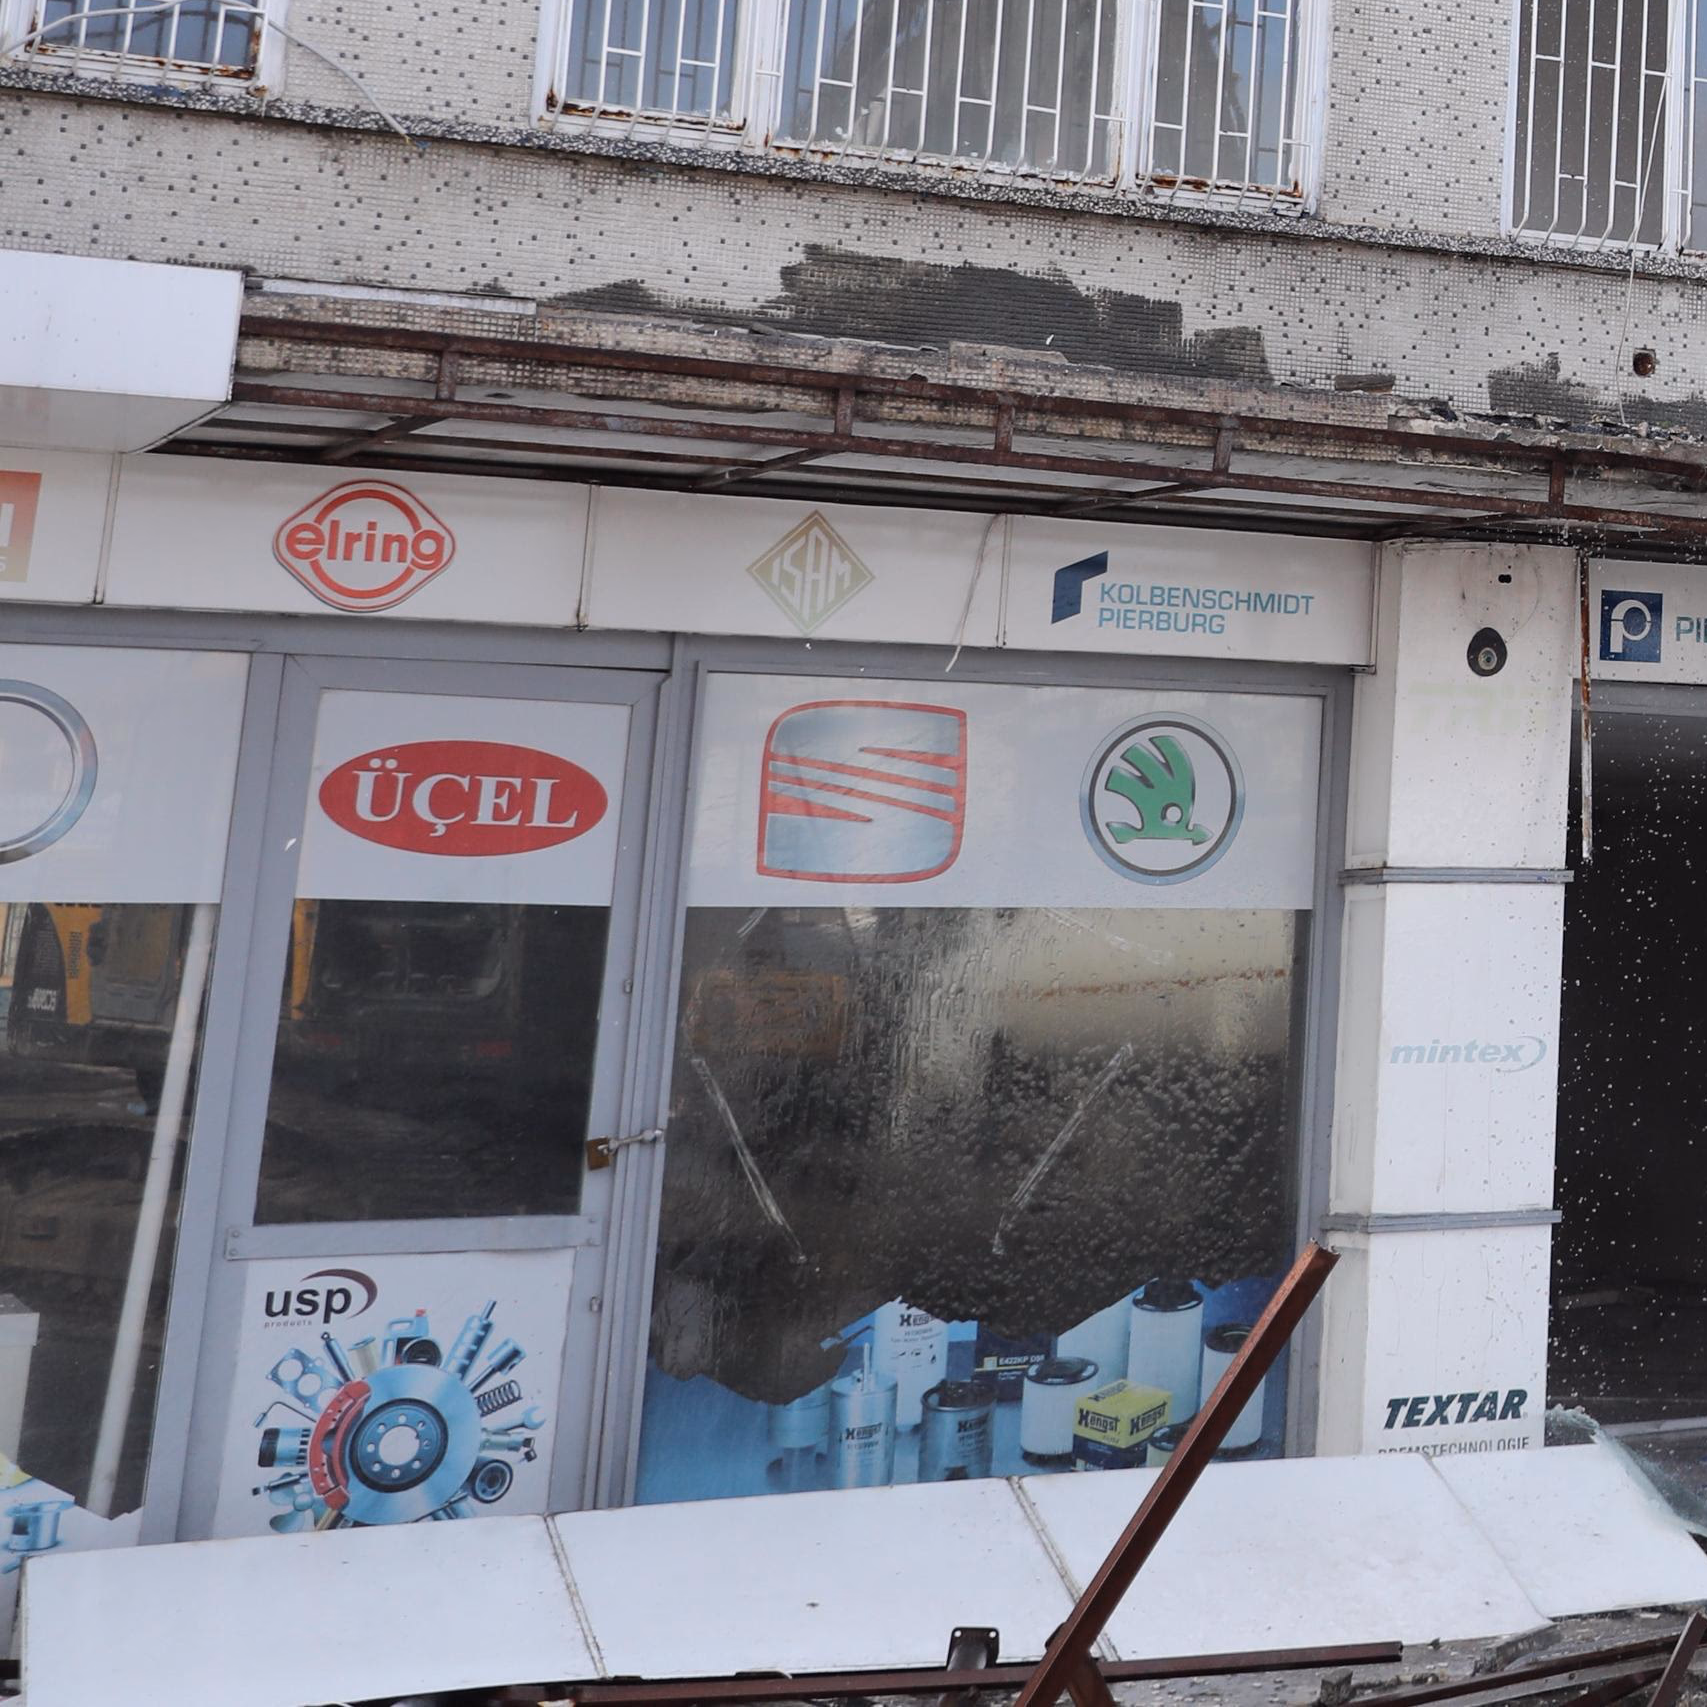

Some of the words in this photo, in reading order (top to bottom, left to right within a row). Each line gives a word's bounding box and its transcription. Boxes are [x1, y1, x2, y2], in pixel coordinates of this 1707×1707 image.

[285, 519, 446, 571] elring
[770, 525, 853, 623] ISAM
[1099, 582, 1316, 616] KOLBENSCHMIDT
[1098, 609, 1226, 635] PIERBURG
[352, 758, 579, 838] ÜÇEL
[1390, 1039, 1528, 1070] mintex
[265, 1287, 352, 1324] usp
[264, 1319, 313, 1329] products
[1078, 1407, 1121, 1434] Hengst
[1130, 1401, 1168, 1436] Hengst
[1383, 1388, 1528, 1430] TEXTAR
